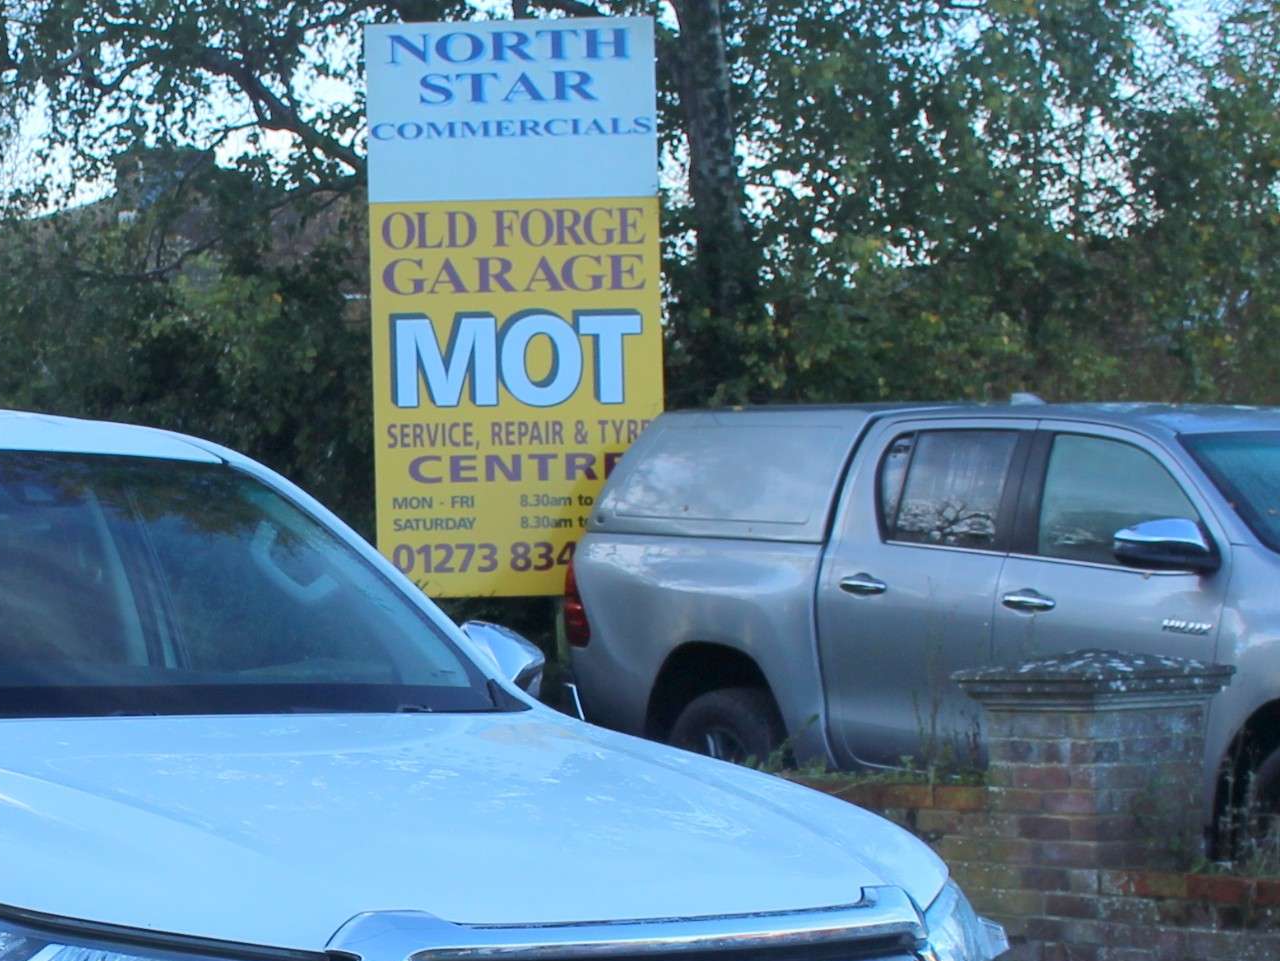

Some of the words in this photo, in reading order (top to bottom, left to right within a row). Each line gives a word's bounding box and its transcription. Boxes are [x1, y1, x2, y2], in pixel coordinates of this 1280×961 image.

[386, 28, 630, 64] NORTH
[420, 70, 598, 105] STAR
[371, 116, 652, 141] COMMERCIALS
[381, 210, 477, 250] OLD
[492, 207, 646, 247] FORGE
[382, 254, 646, 295] GARAGE
[389, 308, 643, 408] MOT
[387, 422, 480, 450] SERVICE,
[491, 420, 564, 446] REPAIR
[574, 420, 589, 444] &
[392, 496, 433, 510] MON
[451, 495, 475, 509] FRI
[520, 494, 572, 507] 8.30am
[578, 494, 594, 507] to
[393, 517, 477, 532] SATURDAY
[520, 515, 573, 528] 8.30am
[393, 543, 499, 574] 01273
